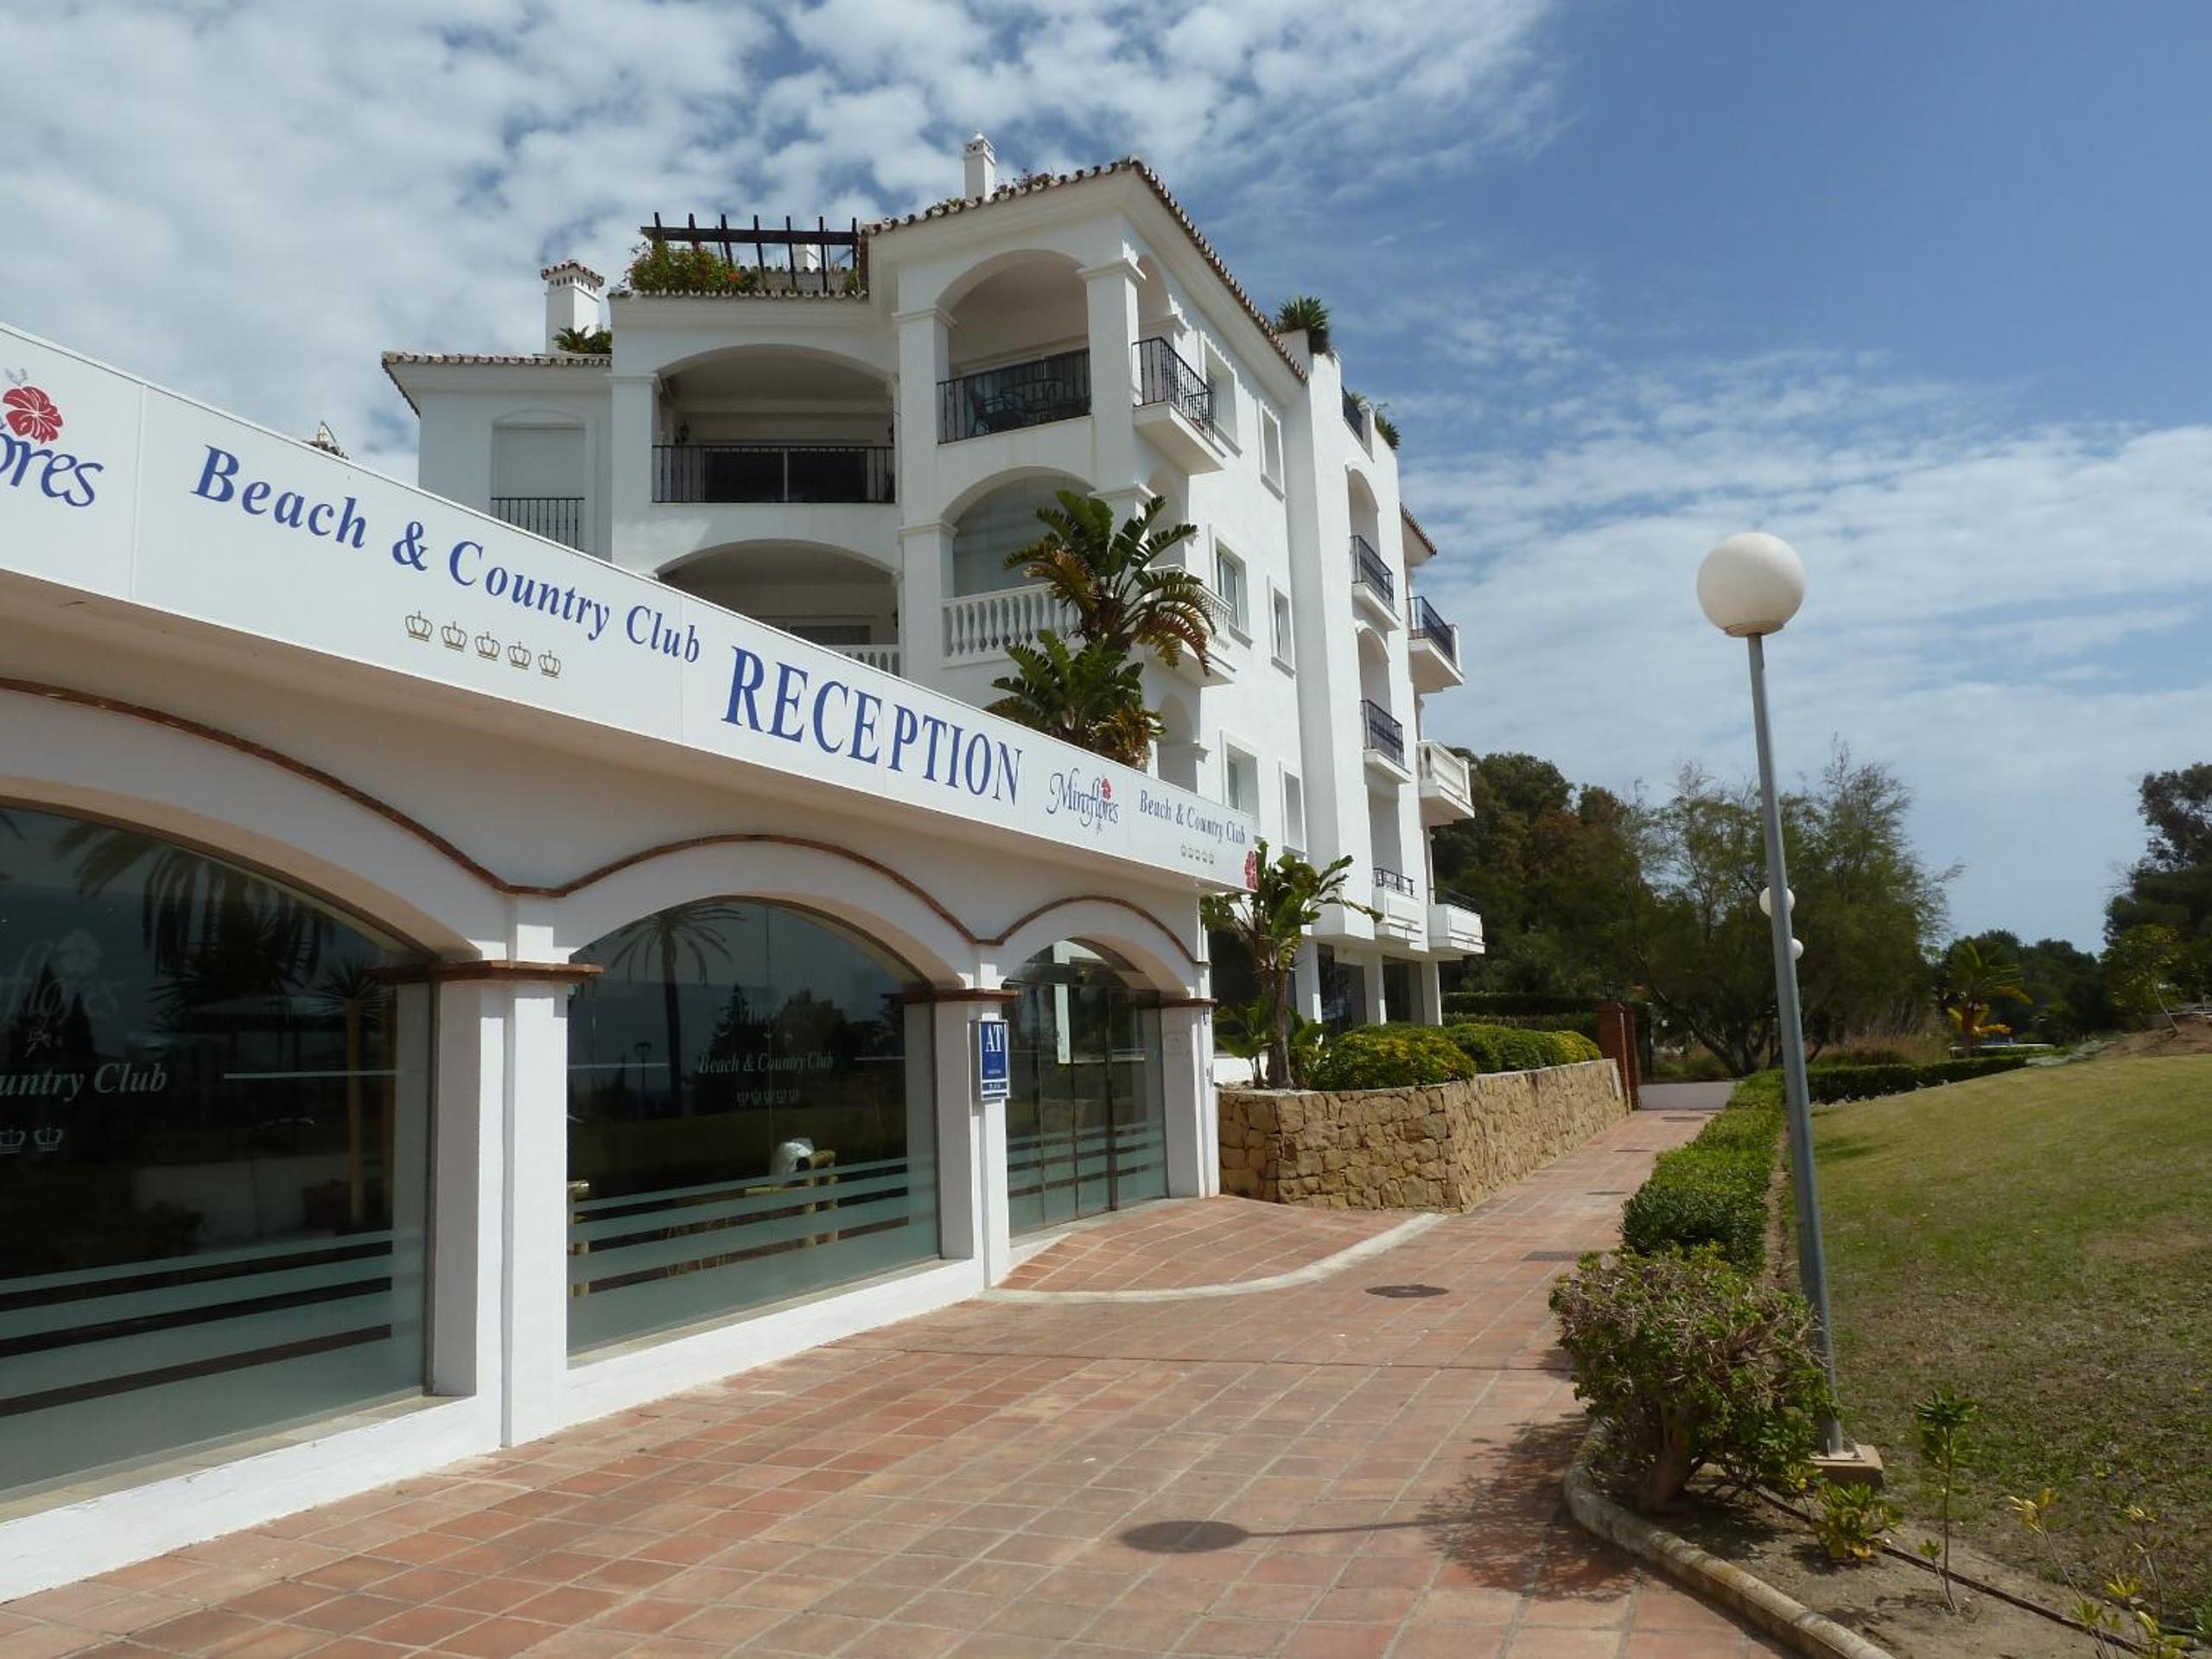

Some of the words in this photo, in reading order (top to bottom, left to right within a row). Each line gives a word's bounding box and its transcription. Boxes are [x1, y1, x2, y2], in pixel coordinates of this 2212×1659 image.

[190, 444, 367, 550] Beach
[391, 520, 429, 572] &
[449, 541, 611, 641] Country
[626, 605, 702, 664] Club
[721, 645, 1023, 805] RECEPTION
[1046, 767, 1119, 827] Miraflores
[1139, 790, 1172, 821] Beach
[1176, 803, 1184, 826] &
[1187, 806, 1223, 843] Country
[1227, 821, 1245, 844] Club
[698, 1052, 740, 1074] Beach
[743, 1053, 754, 1072] &
[758, 1052, 805, 1074] Country
[807, 1051, 835, 1070] Club
[985, 1024, 1003, 1052] AT
[93, 1063, 168, 1093] Club
